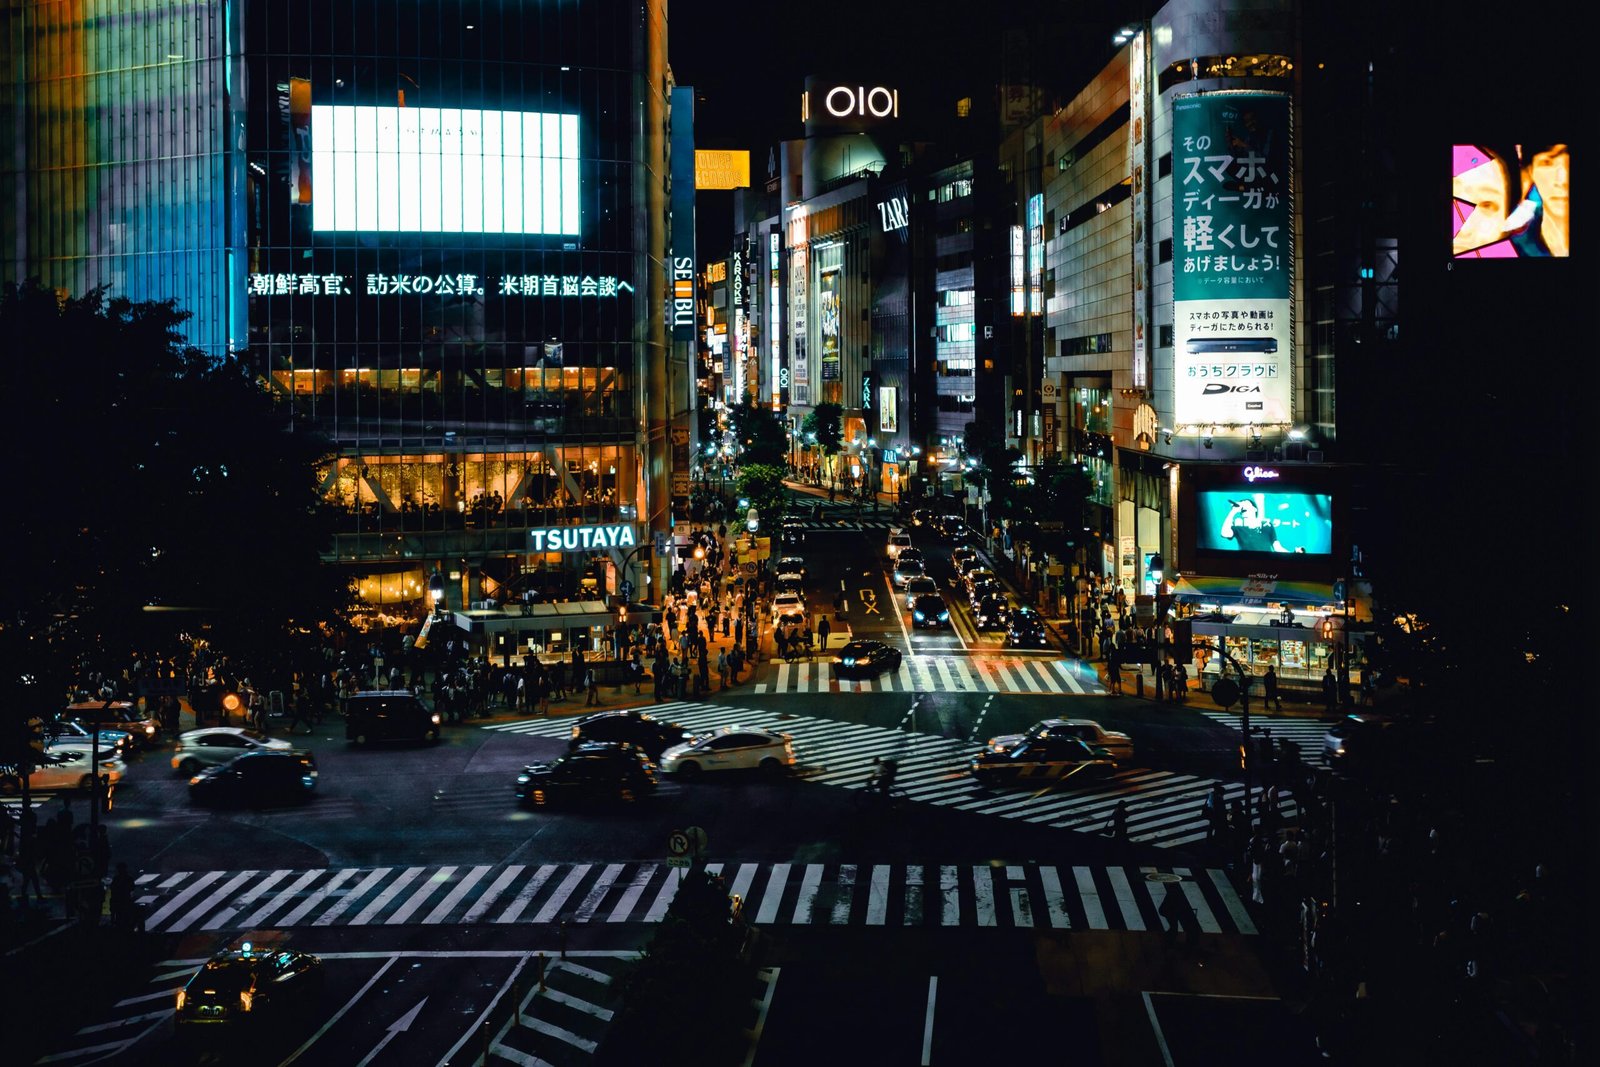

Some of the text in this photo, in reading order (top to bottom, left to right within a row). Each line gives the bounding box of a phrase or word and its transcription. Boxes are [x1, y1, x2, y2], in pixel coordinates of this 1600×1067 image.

[1176, 103, 1202, 111] Panasonic
[1183, 135, 1212, 152] その
[1183, 150, 1279, 186] スマホ、
[1183, 187, 1280, 212] ディーガが
[1183, 215, 1280, 253] 軽くして
[1183, 254, 1280, 273] あげましょう!
[733, 252, 743, 305] KARAOKE
[1189, 310, 1274, 320] スマホの写真や動画は
[1187, 365, 1277, 378] おうちクラウド
[863, 377, 871, 409] ZARA
[1202, 383, 1261, 395] DIGA
[884, 450, 897, 463] ZARA
[531, 526, 634, 550] TSUTAYA
